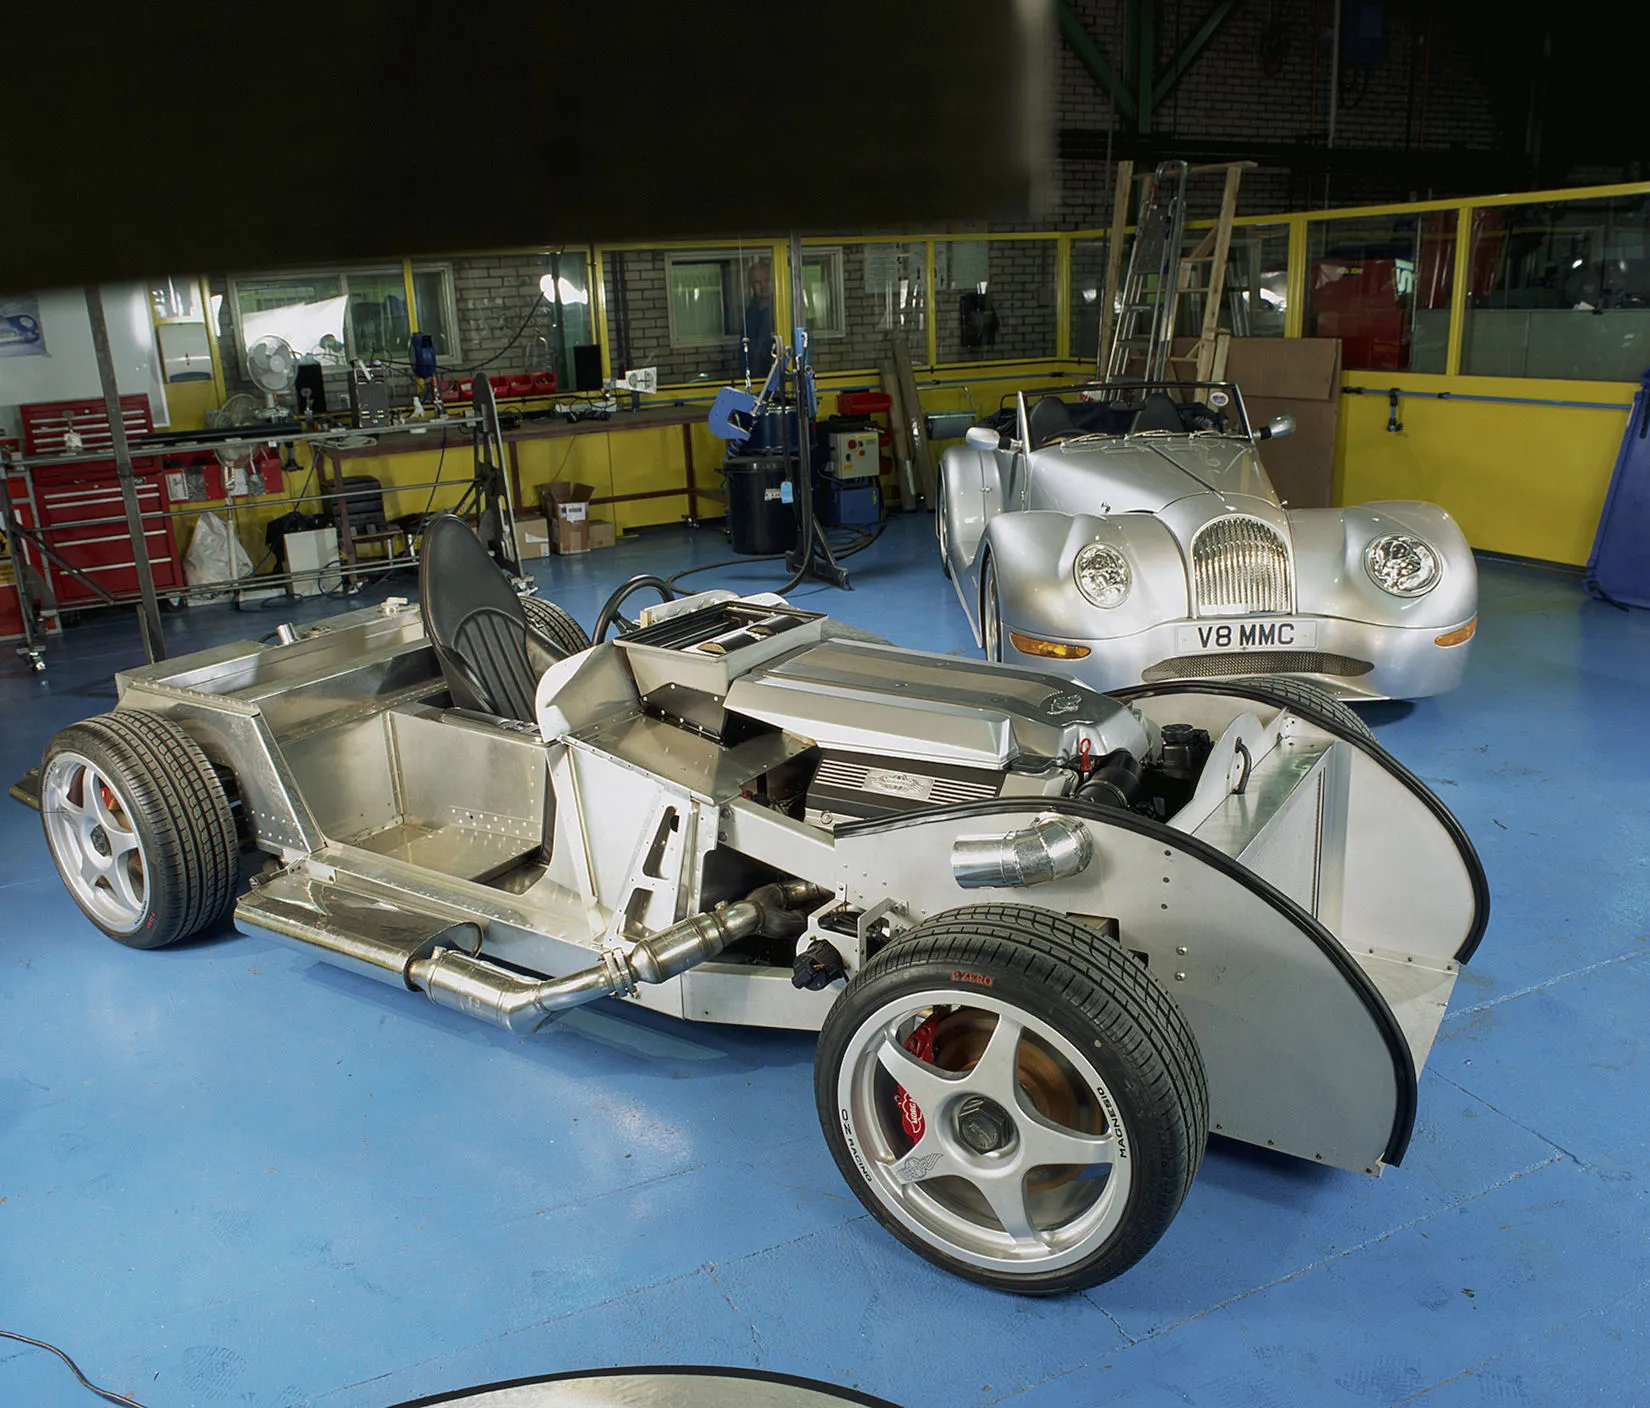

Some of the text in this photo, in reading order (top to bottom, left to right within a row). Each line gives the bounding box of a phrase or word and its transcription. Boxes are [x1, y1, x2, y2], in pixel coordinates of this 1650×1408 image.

[1198, 623, 1294, 648] V8 MMC
[1097, 1087, 1127, 1158] MAGNESIO
[848, 1138, 872, 1182] RACING
